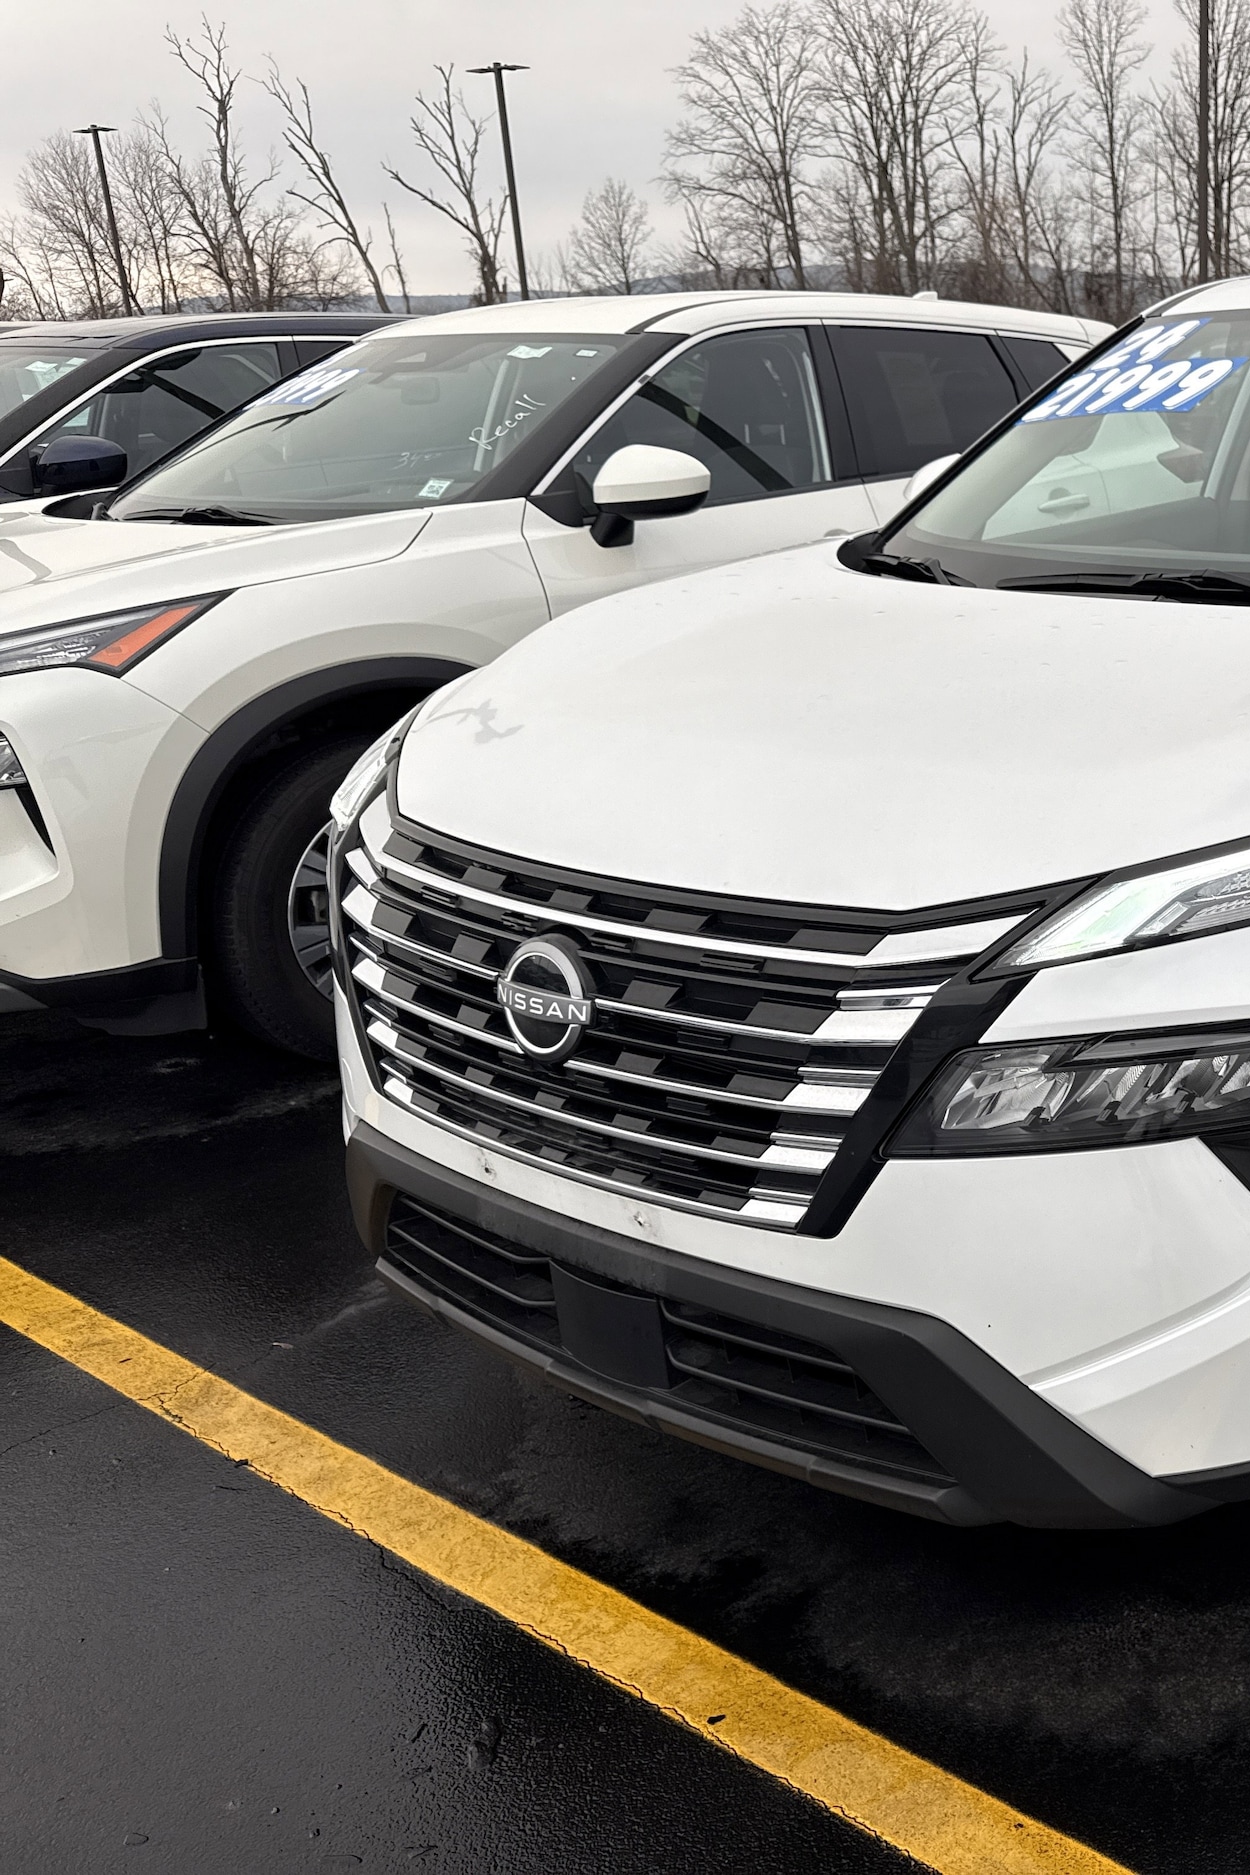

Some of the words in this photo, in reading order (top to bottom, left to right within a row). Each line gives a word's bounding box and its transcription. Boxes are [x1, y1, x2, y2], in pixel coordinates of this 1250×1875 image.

[1021, 359, 1233, 422] 21999
[469, 394, 546, 450] Recall
[497, 983, 587, 1022] NISSAN
